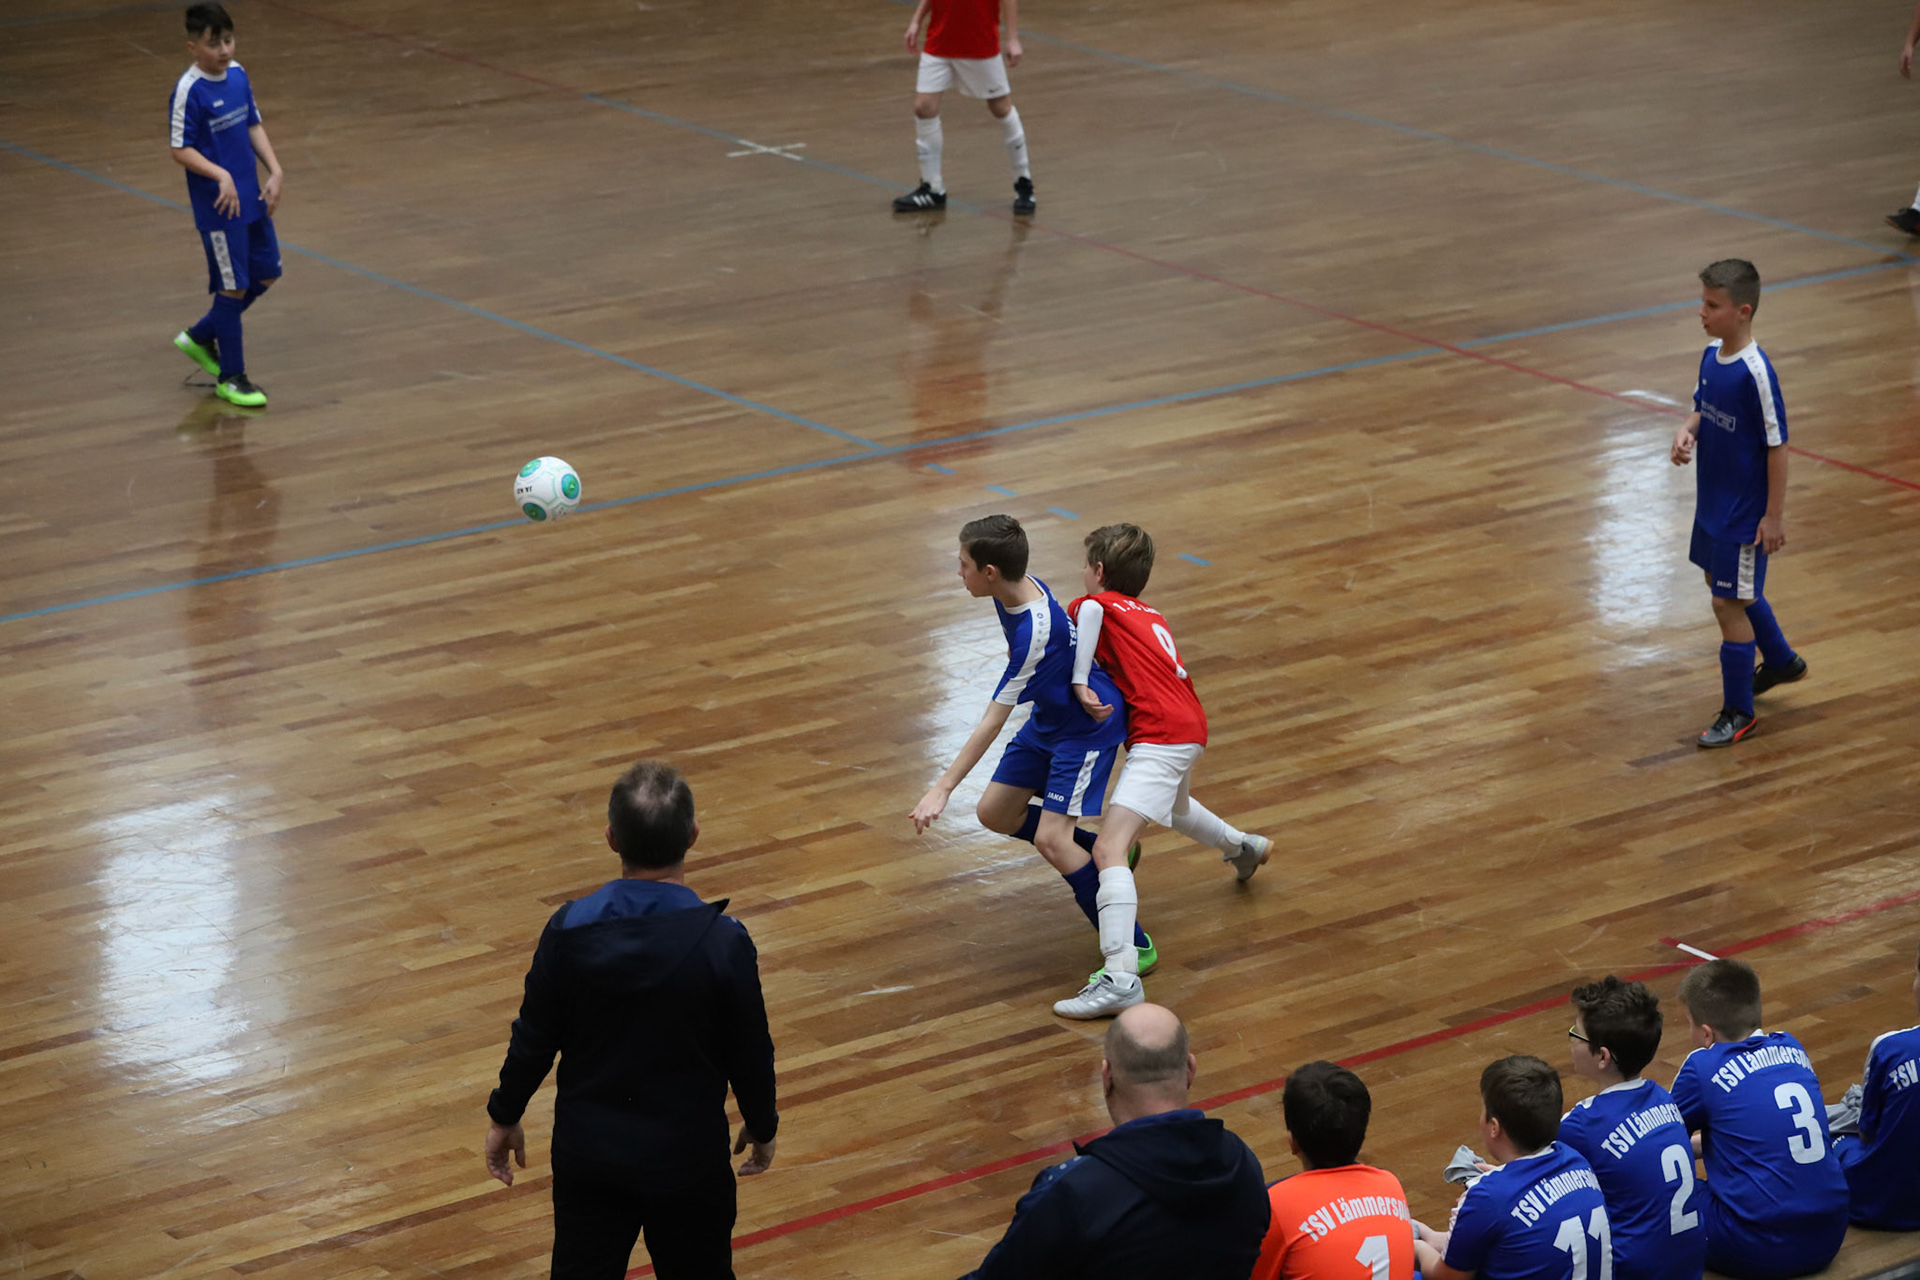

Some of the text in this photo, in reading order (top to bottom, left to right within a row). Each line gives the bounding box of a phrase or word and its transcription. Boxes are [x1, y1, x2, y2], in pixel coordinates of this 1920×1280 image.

[1047, 791, 1065, 802] JAKO
[1711, 1059, 1746, 1093] TSV
[1889, 1059, 1919, 1091] TSV
[1601, 1123, 1636, 1160] TSV
[1773, 1082, 1826, 1164] 3
[1660, 1144, 1699, 1236] 2
[1299, 1206, 1336, 1242] TSV
[1510, 1190, 1546, 1228] TSV
[1355, 1234, 1390, 1280] 1
[1553, 1205, 1613, 1280] 11
